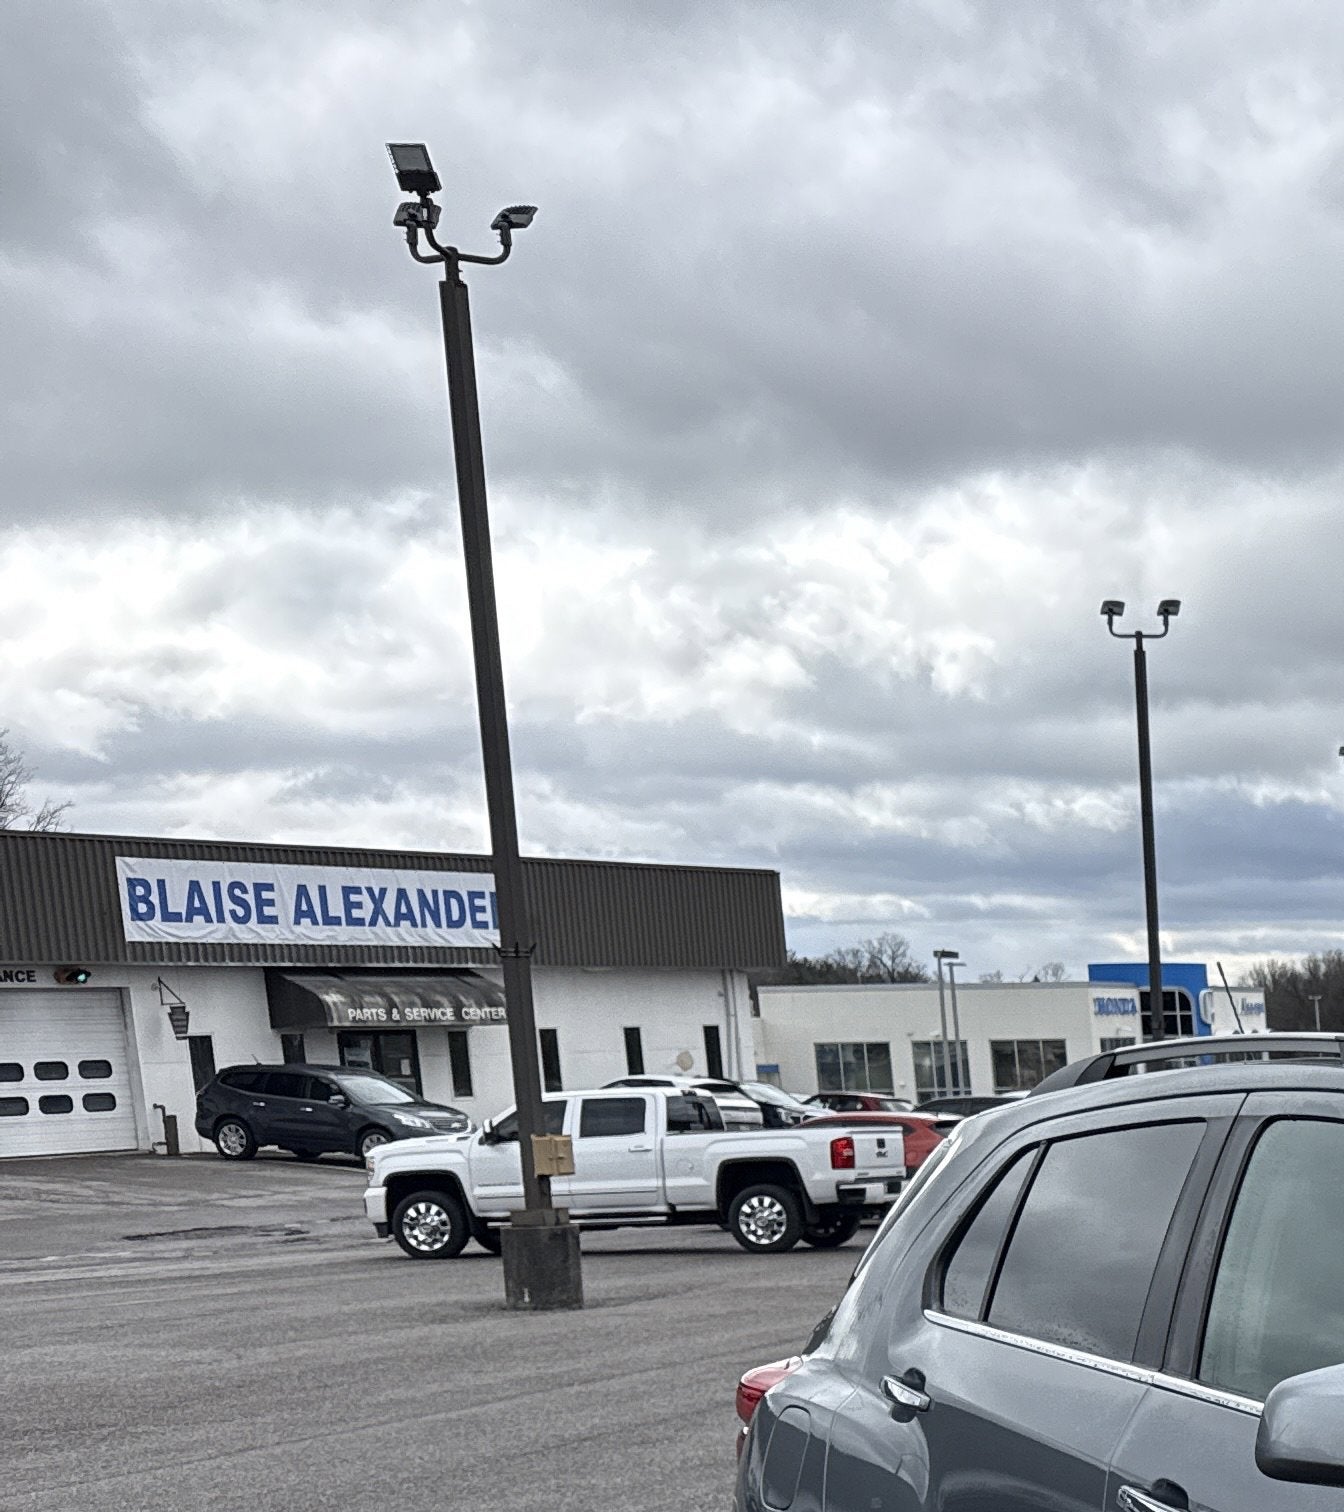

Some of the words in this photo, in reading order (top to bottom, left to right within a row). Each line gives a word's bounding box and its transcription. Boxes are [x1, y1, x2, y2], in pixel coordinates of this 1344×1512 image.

[126, 877, 279, 924] BLAISE
[0, 969, 37, 983] NCE
[348, 1008, 387, 1021] PARTS
[391, 1009, 401, 1021] &
[404, 1007, 456, 1021] SERVICE
[461, 1006, 507, 1021] CENTER
